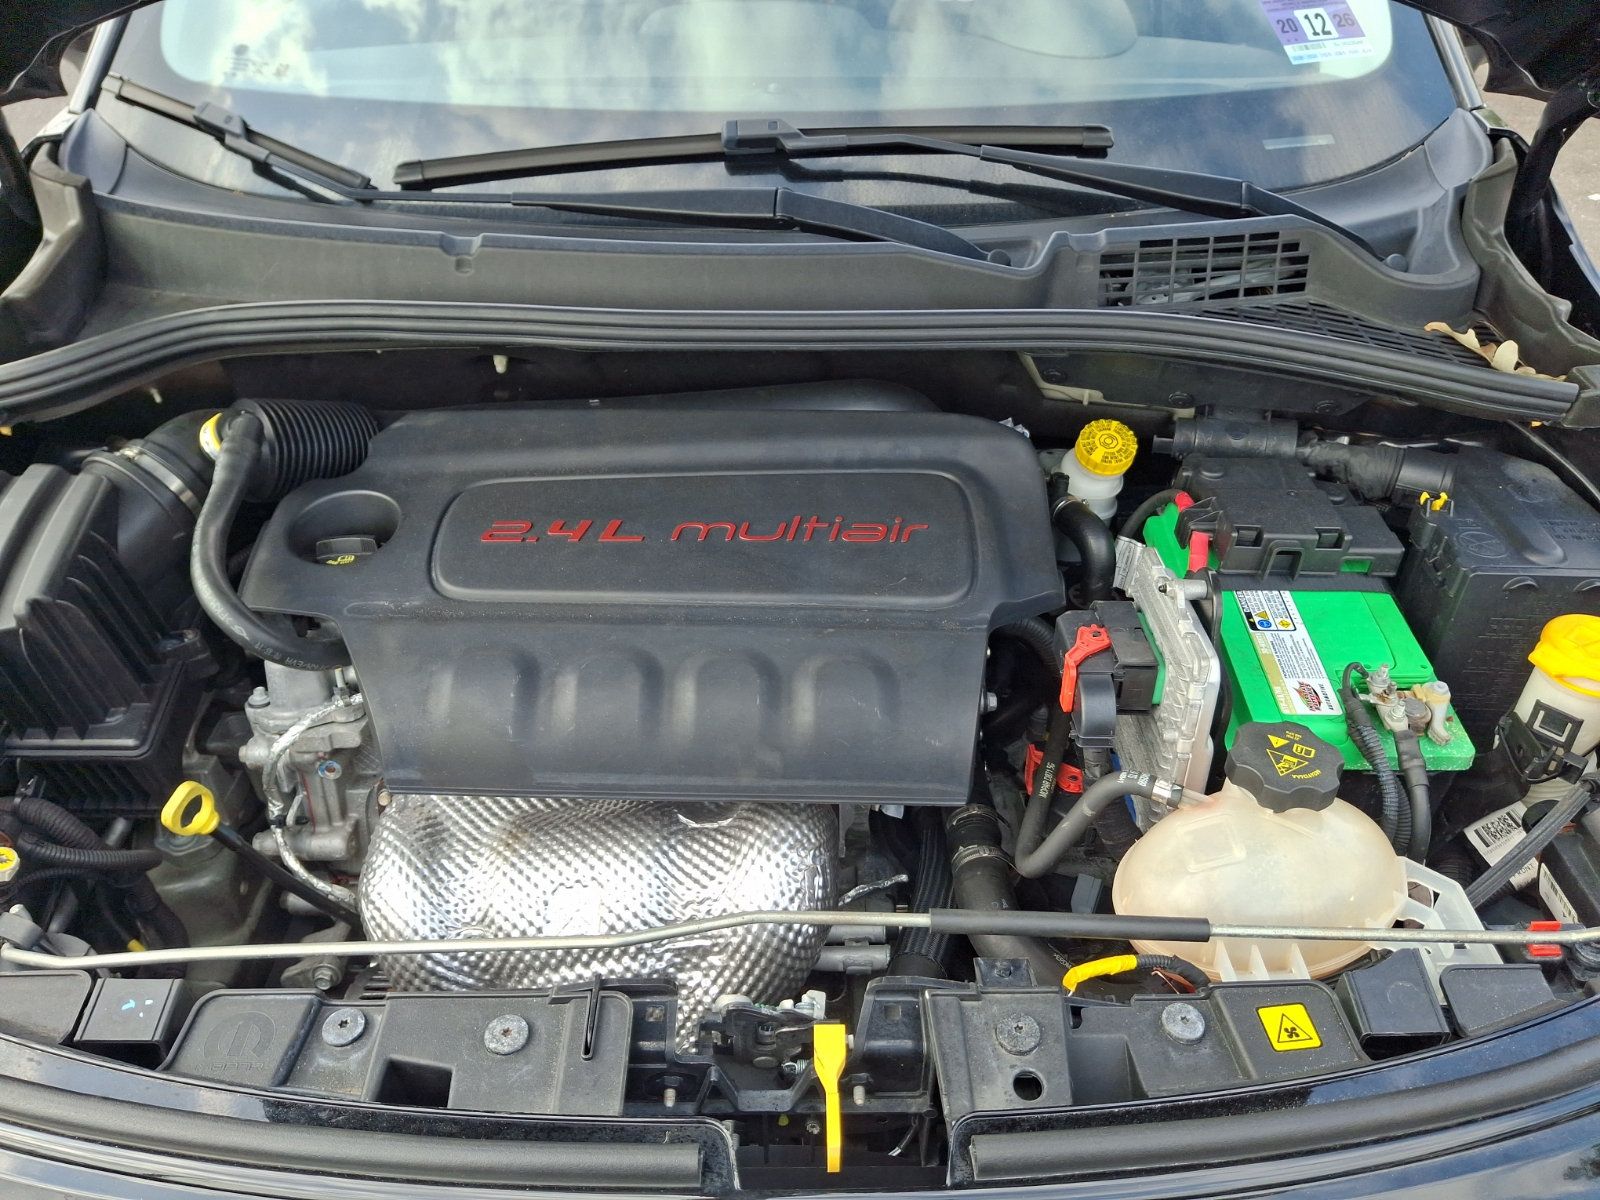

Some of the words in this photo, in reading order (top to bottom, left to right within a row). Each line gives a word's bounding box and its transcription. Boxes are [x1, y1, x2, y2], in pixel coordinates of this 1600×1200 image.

[1276, 18, 1299, 34] 20
[1304, 12, 1332, 36] 12
[1332, 13, 1356, 28] 26
[671, 515, 929, 543] multiair
[1318, 683, 1334, 710] AUTOMOTIVE
